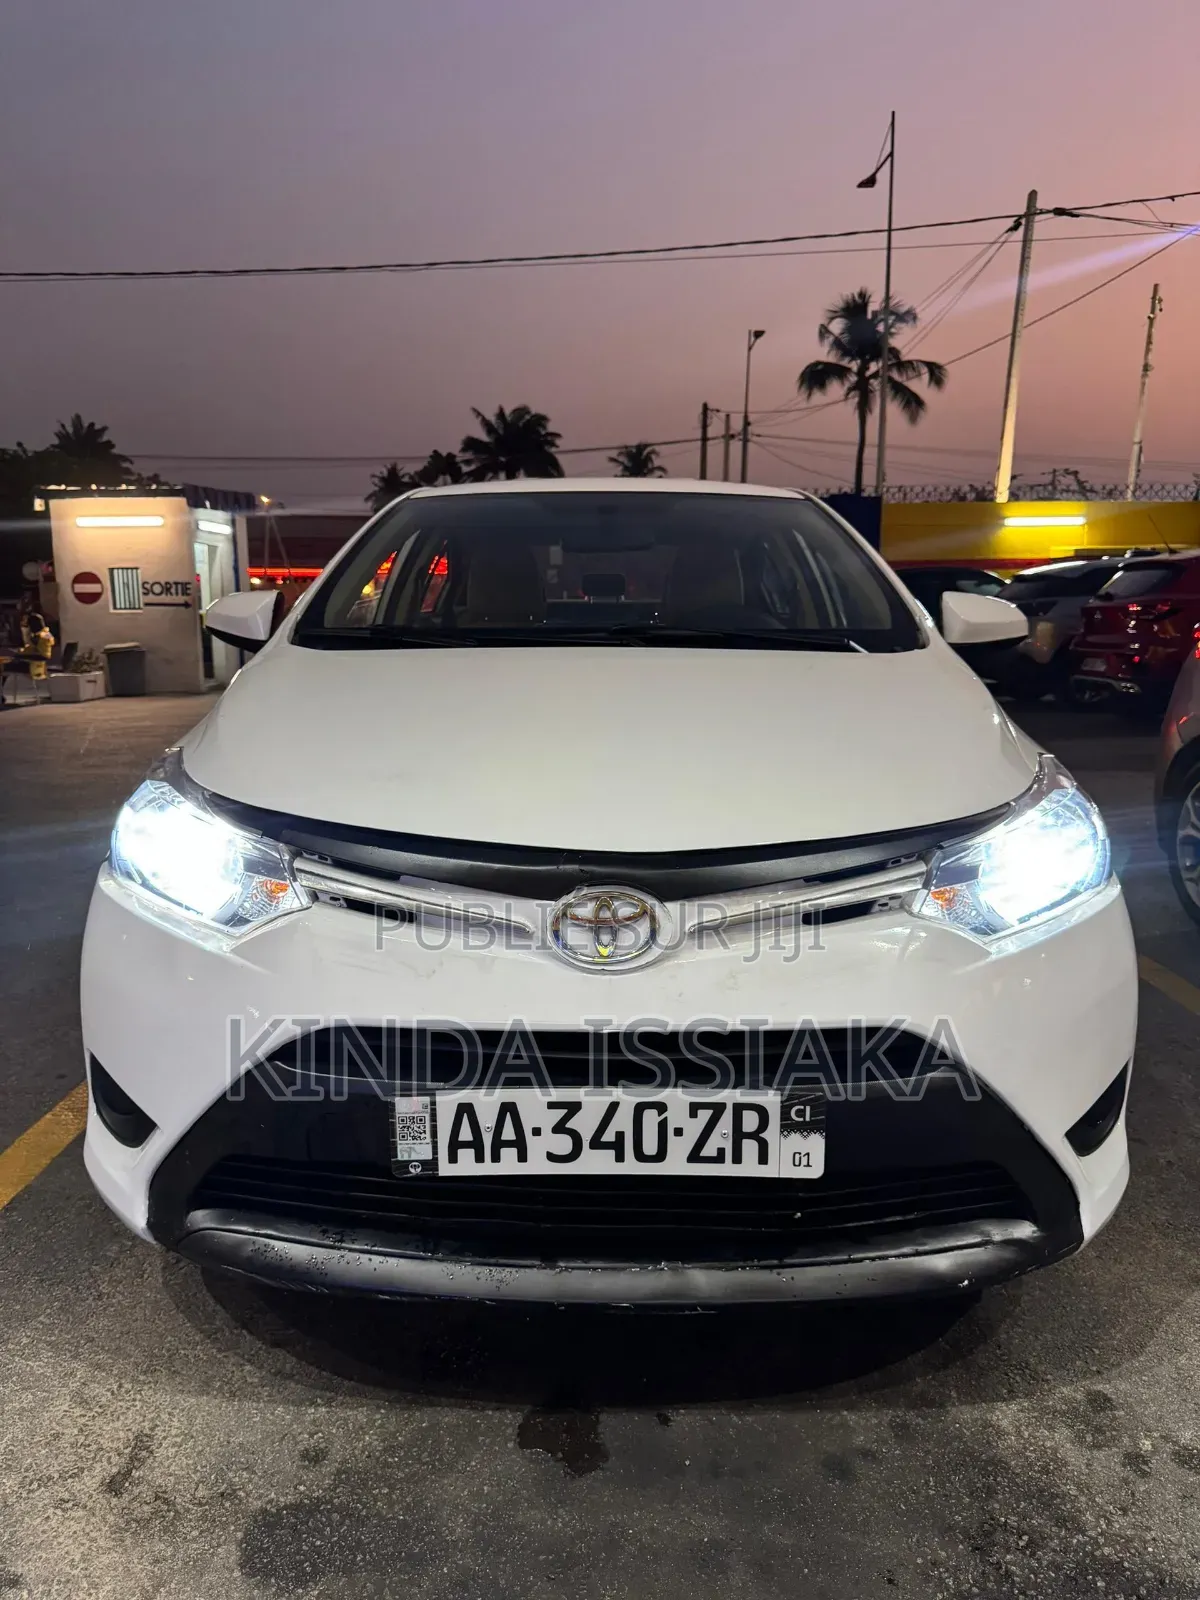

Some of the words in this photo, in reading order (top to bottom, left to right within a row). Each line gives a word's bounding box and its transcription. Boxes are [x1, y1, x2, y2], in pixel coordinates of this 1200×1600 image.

[142, 581, 192, 597] SORTIE
[790, 1105, 811, 1122] CI
[792, 1151, 812, 1168] 01
